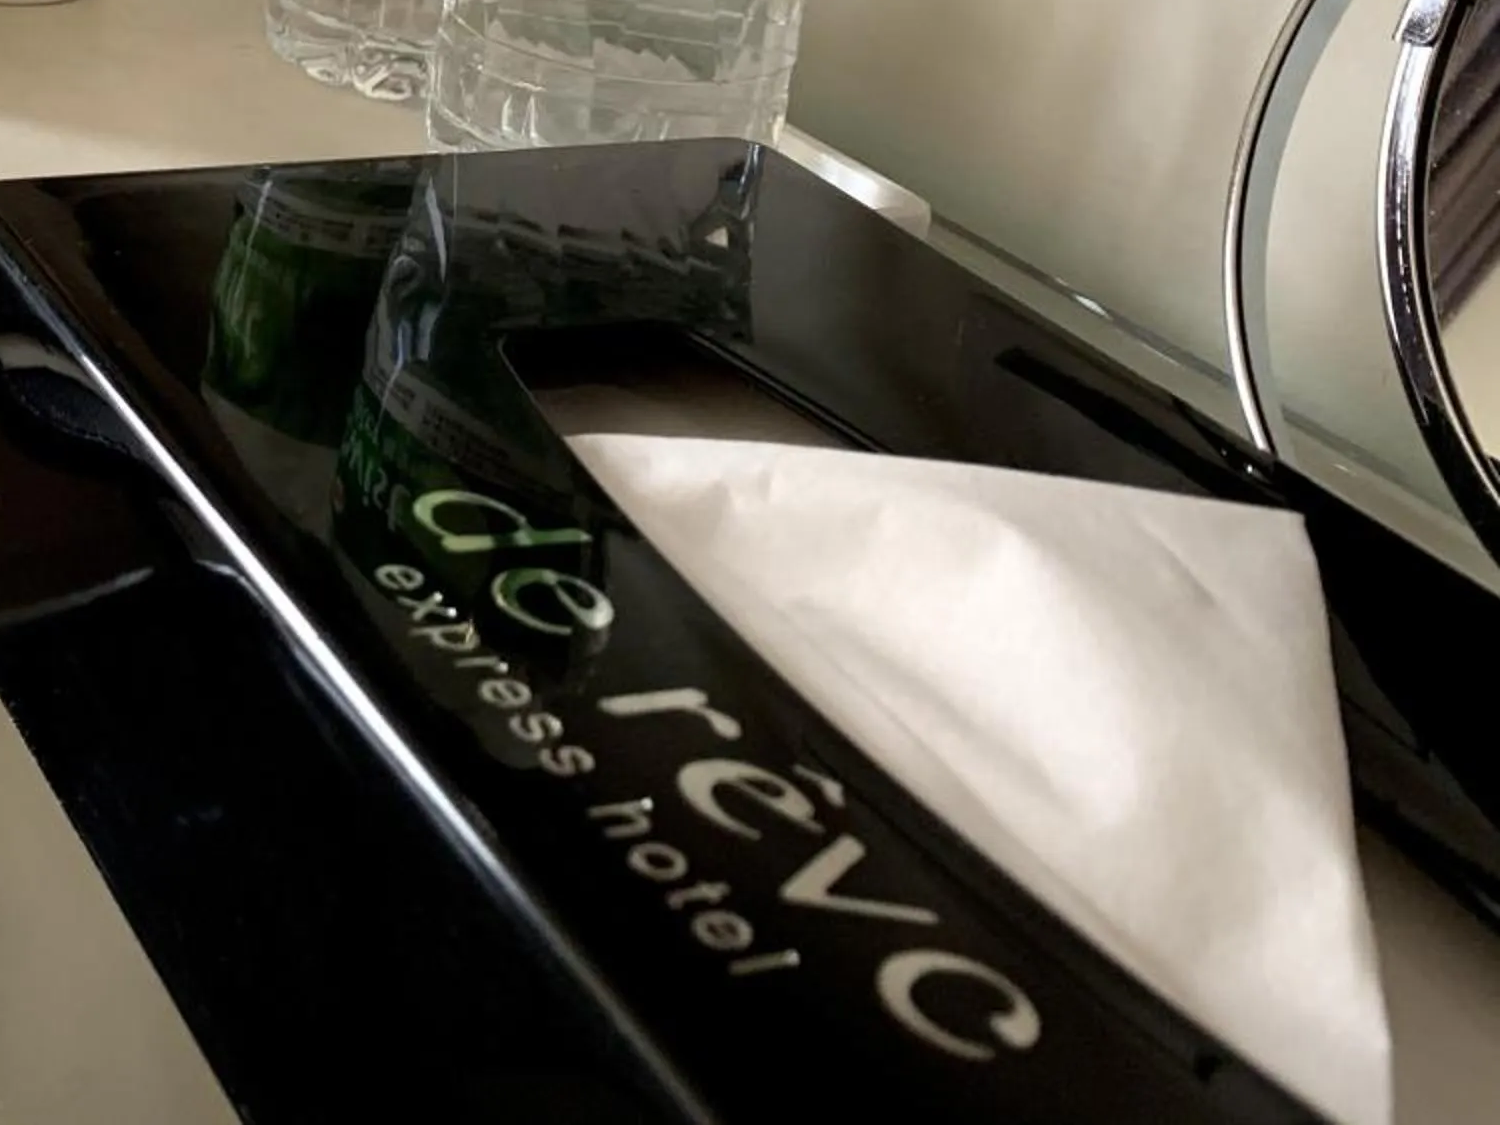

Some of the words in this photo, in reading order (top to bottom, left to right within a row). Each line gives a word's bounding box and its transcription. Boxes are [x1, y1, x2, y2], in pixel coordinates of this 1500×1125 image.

[413, 489, 615, 635] de
[374, 563, 596, 776] express
[588, 796, 801, 977] hotel
